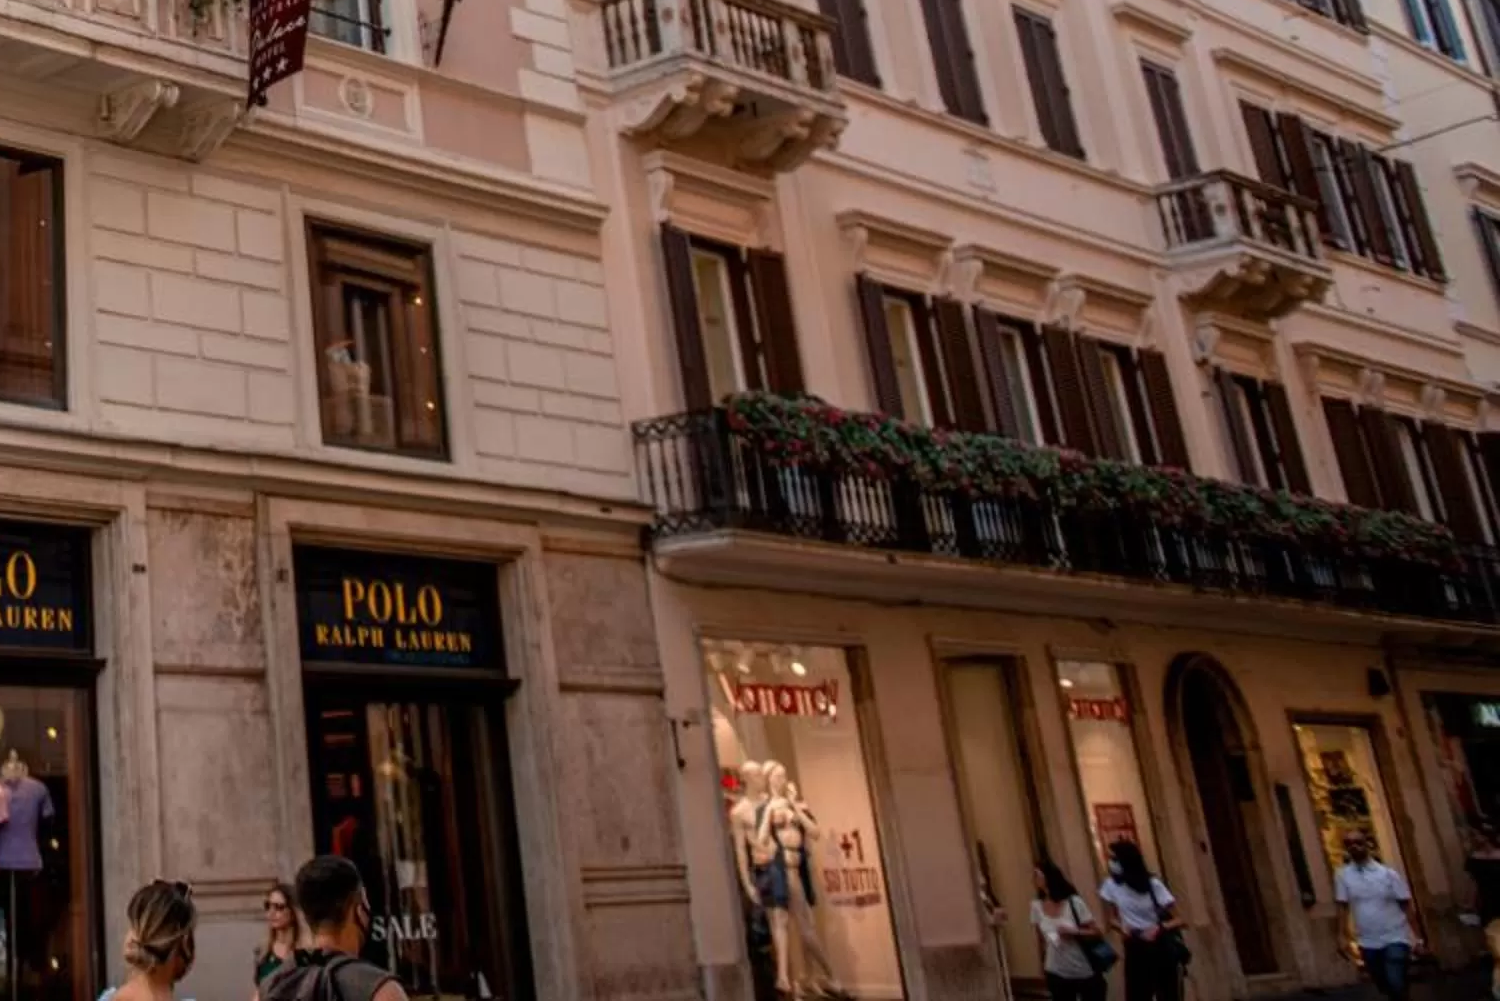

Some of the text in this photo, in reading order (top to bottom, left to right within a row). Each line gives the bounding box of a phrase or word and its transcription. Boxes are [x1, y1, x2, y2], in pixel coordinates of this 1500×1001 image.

[342, 578, 443, 626] POLO
[315, 623, 473, 653] RALPH LAUREN
[371, 912, 438, 942] SALE
